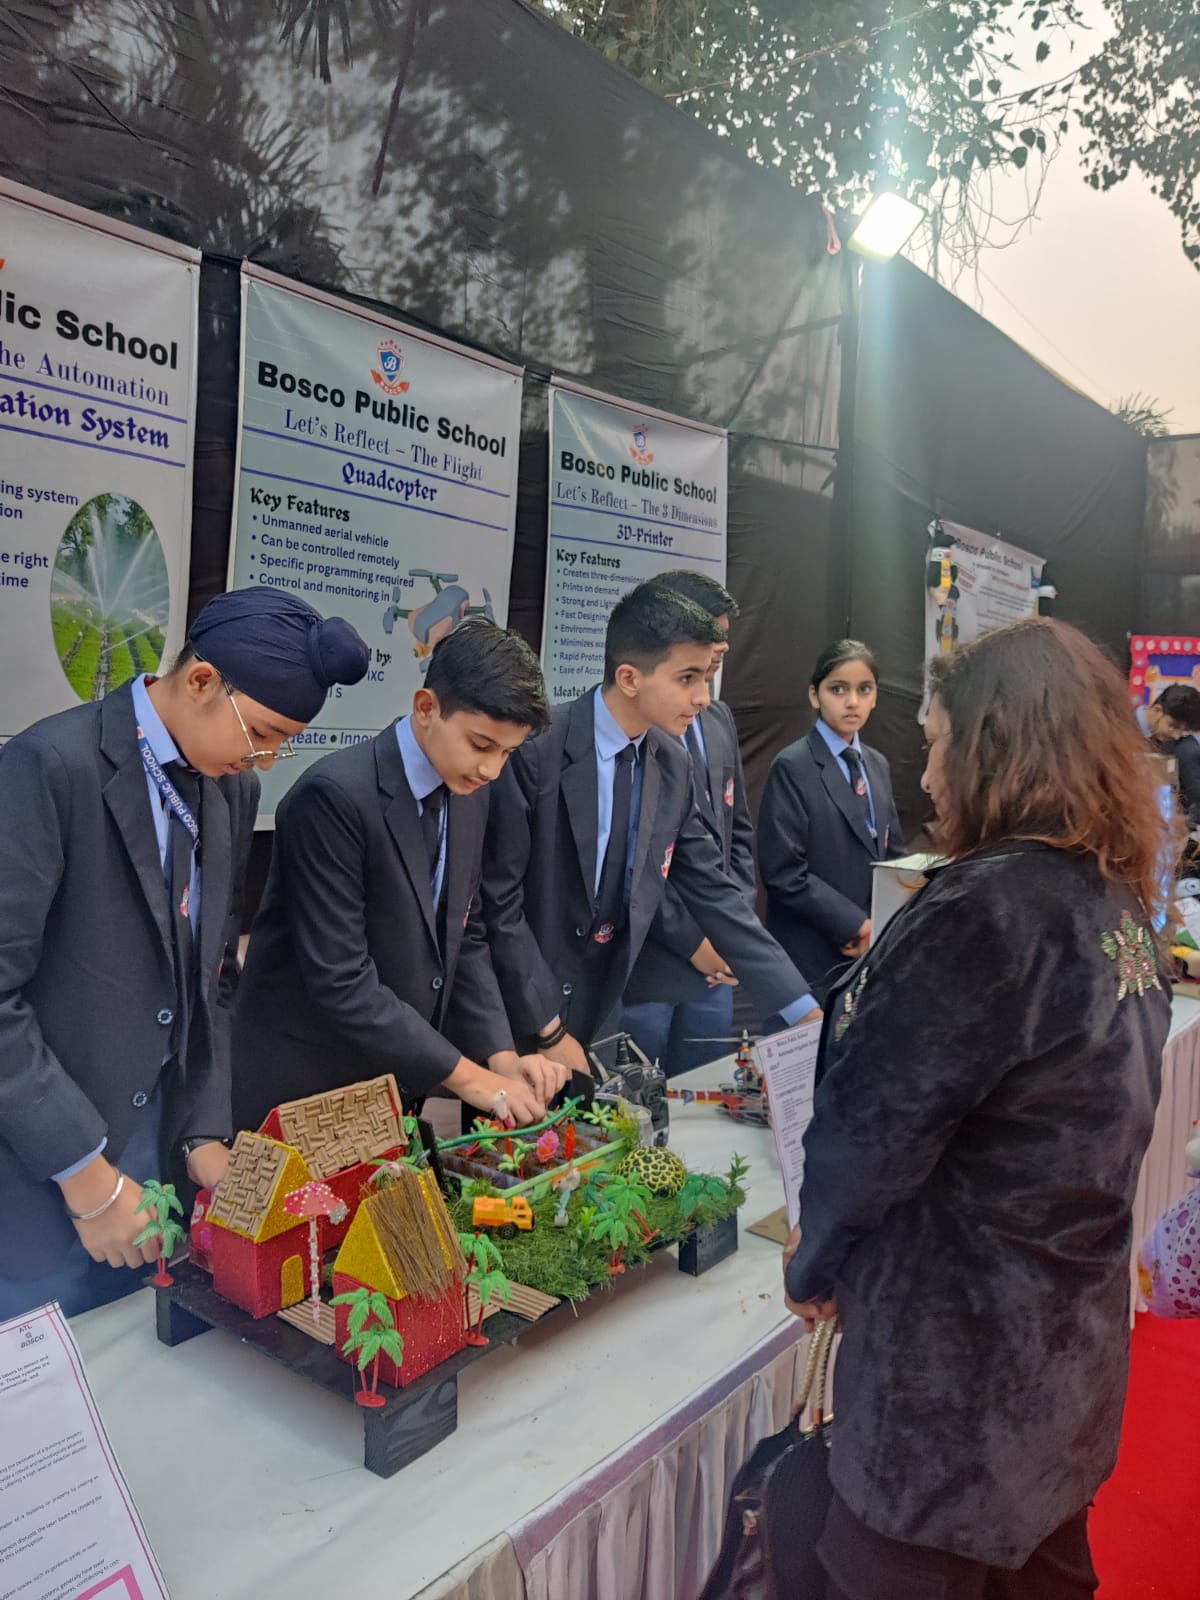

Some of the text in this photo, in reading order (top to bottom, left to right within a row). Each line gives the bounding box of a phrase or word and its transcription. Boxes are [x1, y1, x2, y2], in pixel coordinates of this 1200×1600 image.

[56, 310, 177, 369] School
[36, 353, 169, 406] Automation
[258, 361, 505, 457] Bosco Public School
[81, 407, 169, 448] System
[334, 422, 390, 454] Reflect
[411, 444, 438, 468] The
[443, 455, 482, 482] Flight
[342, 462, 437, 501] Quadcopter
[561, 451, 717, 504] Bosco Public School
[250, 487, 350, 522] Key Features
[592, 488, 628, 510] Reflect
[641, 498, 659, 516] The
[662, 503, 668, 519] 3
[671, 505, 718, 529] Dimensions
[262, 514, 389, 548] Unmanned aerial vehicle
[617, 524, 674, 547] 3D-Printer
[261, 534, 399, 570] Can be controlled remotely
[556, 549, 621, 569] Key Features
[0, 573, 29, 588] ime
[260, 553, 414, 588] Specific programming required
[563, 568, 589, 579] Creates
[259, 573, 300, 590] Control
[303, 578, 323, 593] and
[325, 582, 379, 603] monitoring
[561, 596, 585, 608] Strong
[586, 598, 599, 607] and
[562, 583, 619, 596] Prints on demand
[561, 610, 576, 619] Fast
[561, 624, 603, 635] Environment
[559, 652, 580, 663] Rapid
[560, 638, 594, 648] Minimizes
[559, 666, 575, 675] Ease
[576, 665, 584, 674] of
[141, 744, 166, 783] SCHOOL
[162, 784, 187, 816] PUBLIC
